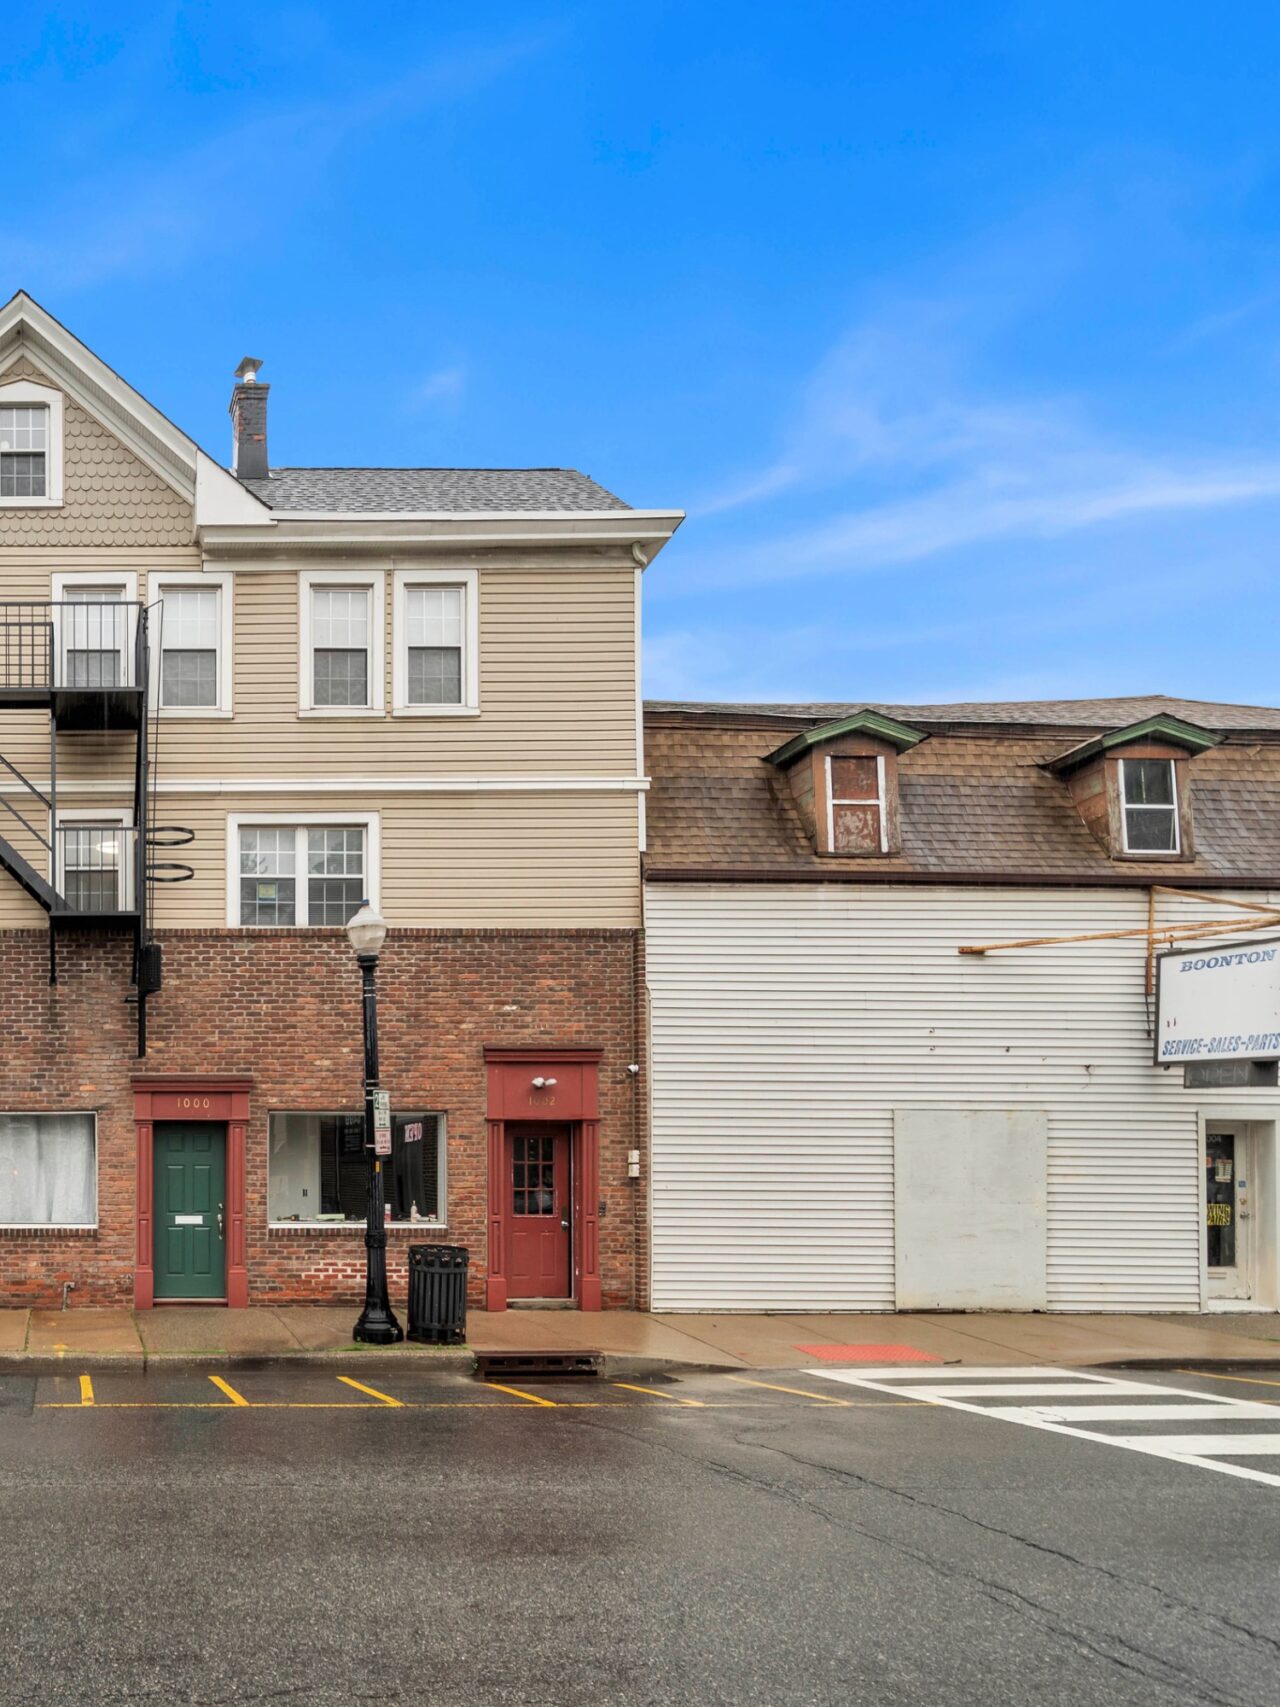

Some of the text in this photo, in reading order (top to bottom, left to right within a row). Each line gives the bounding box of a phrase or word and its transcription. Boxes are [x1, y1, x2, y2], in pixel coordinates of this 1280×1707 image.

[1180, 949, 1278, 972] BOONTON
[1188, 1065, 1249, 1084] OPEN
[177, 1097, 210, 1108] 1000
